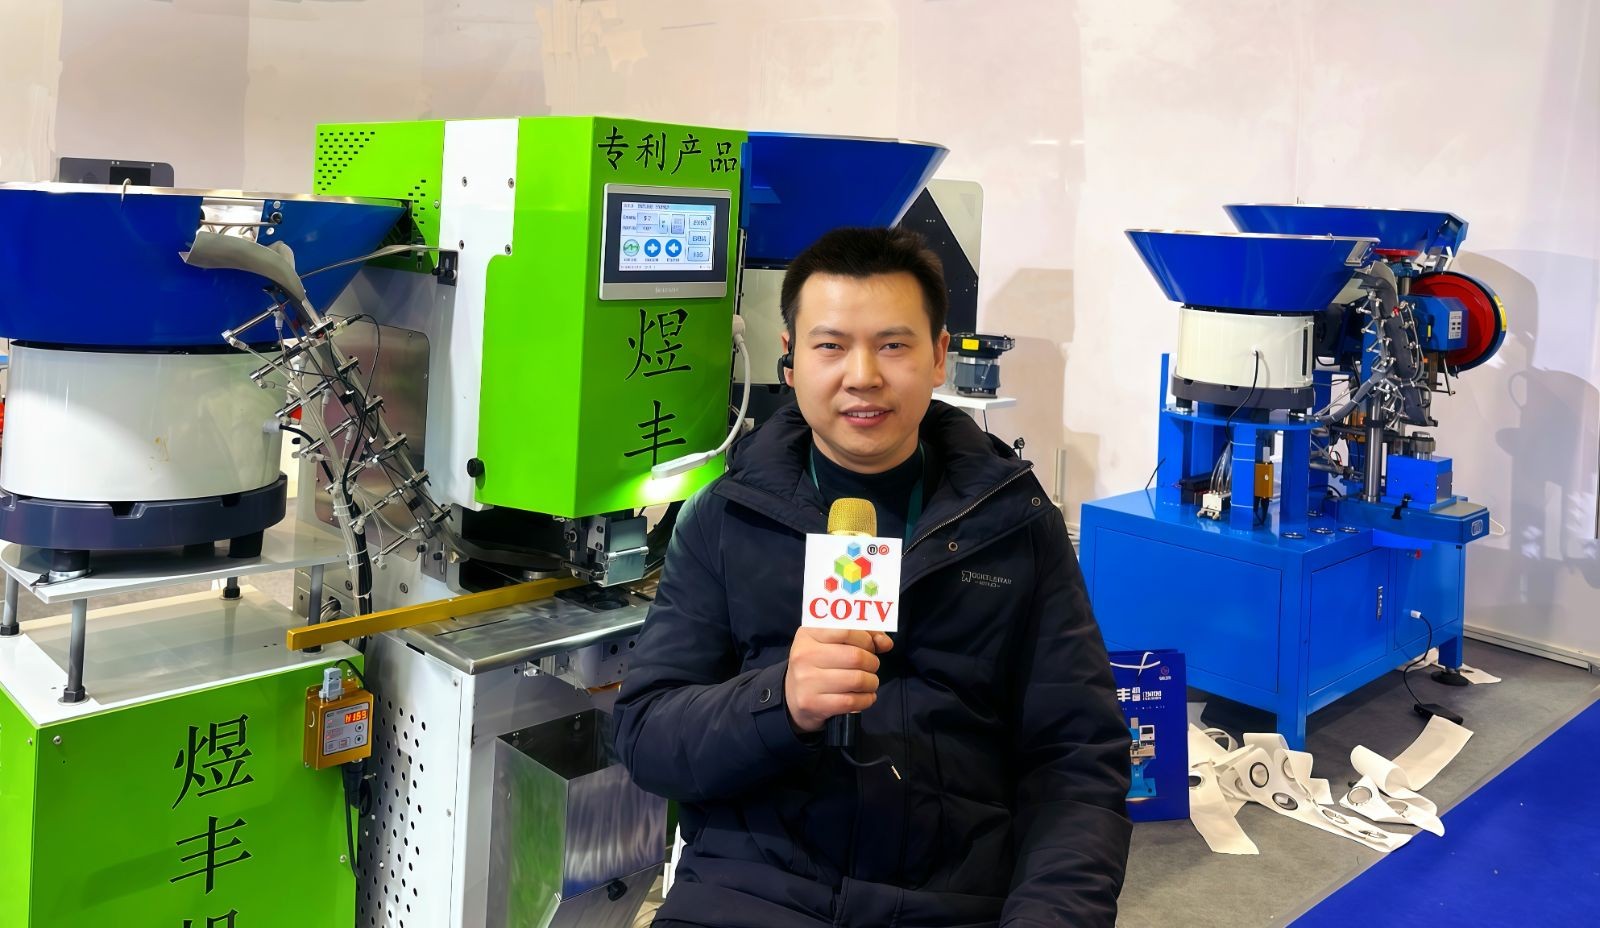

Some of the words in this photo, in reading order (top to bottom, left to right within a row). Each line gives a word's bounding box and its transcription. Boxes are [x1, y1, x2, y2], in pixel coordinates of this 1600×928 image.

[597, 126, 738, 175] 专利产品
[623, 308, 692, 467] 煜丰
[809, 597, 894, 623] COTV
